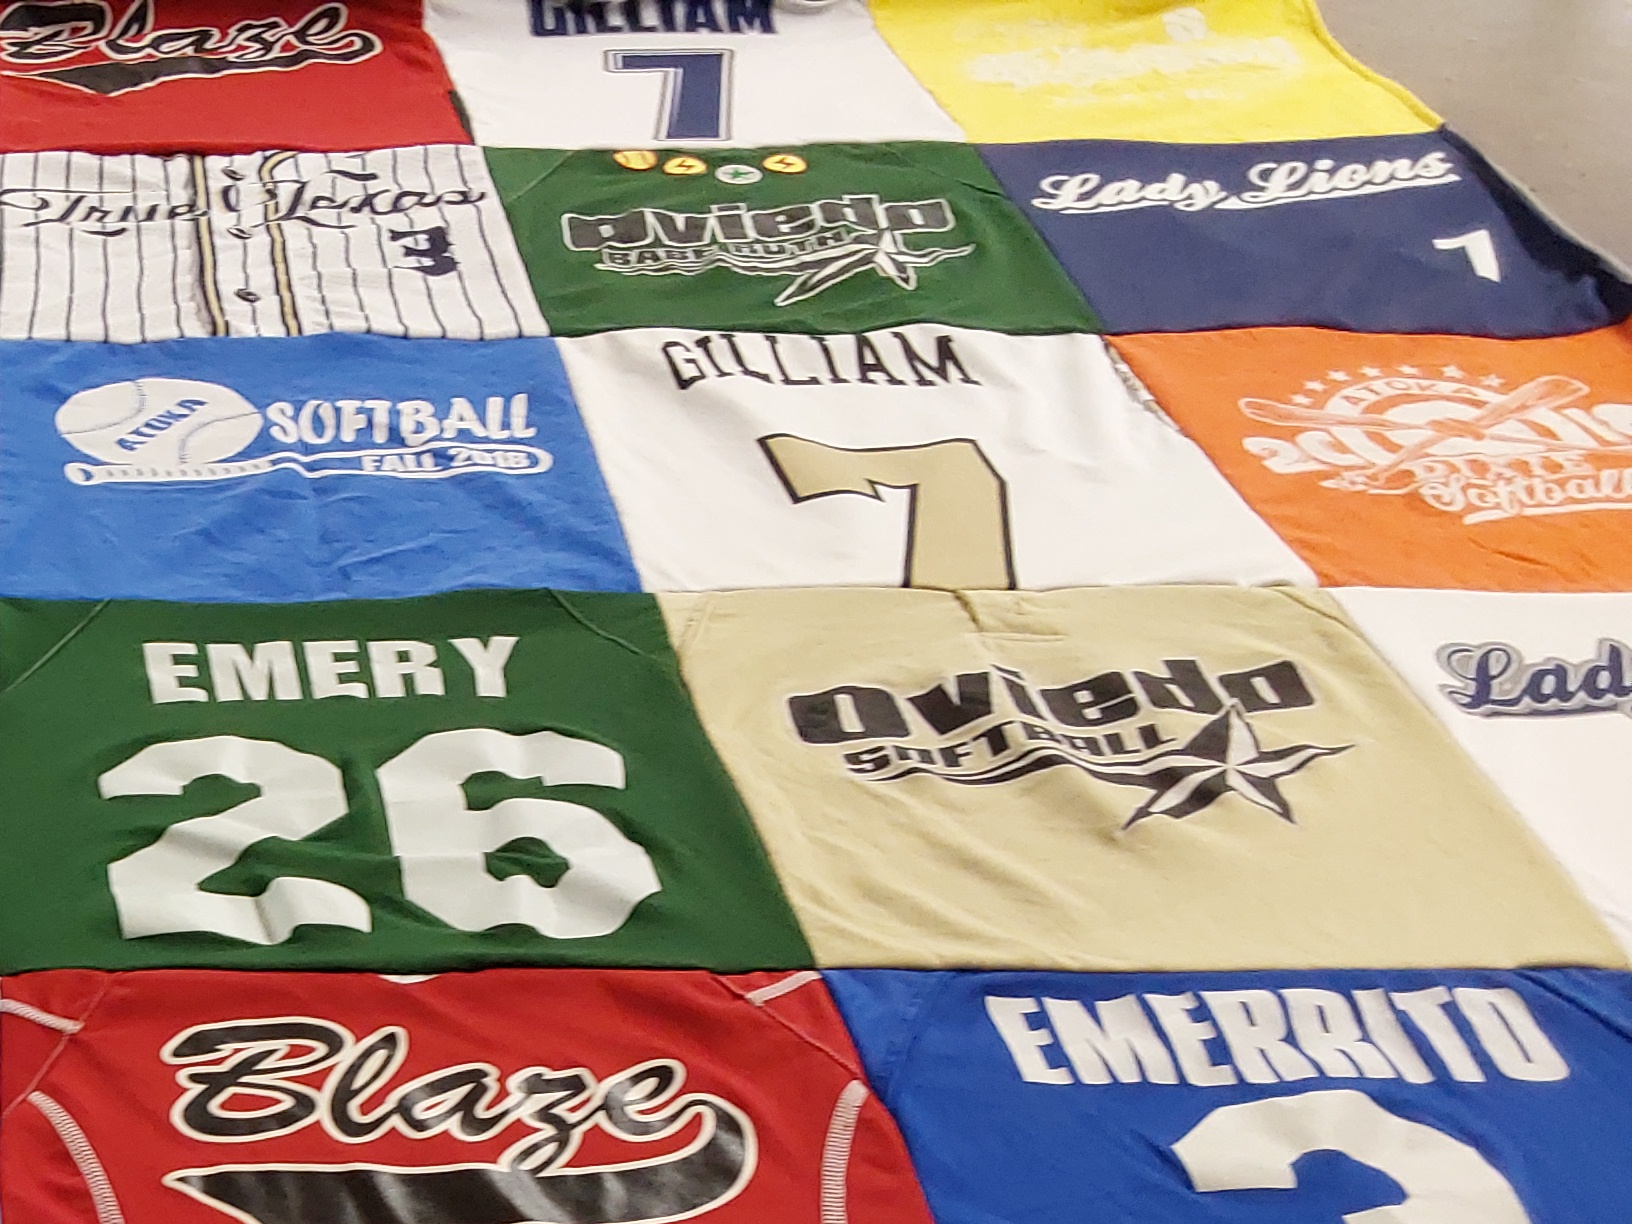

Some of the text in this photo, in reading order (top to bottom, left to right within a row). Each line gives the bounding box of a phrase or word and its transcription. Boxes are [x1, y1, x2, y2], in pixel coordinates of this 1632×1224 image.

[603, 48, 735, 142] 7
[1031, 151, 1456, 211] Lady Lions
[389, 226, 461, 277] 3
[1432, 228, 1501, 283] 7
[661, 331, 983, 390] GILLIAM
[115, 398, 211, 452] ATOKA
[266, 393, 537, 446] SOFTBALL
[363, 454, 441, 474] FALL
[756, 432, 1017, 591] 7
[141, 635, 520, 704] EMERY
[787, 658, 1317, 745] Oviedo
[1436, 638, 1632, 710] Lad
[96, 727, 663, 945] 26
[984, 986, 1571, 1087] EMERRITO
[159, 1014, 759, 1176] Blaze
